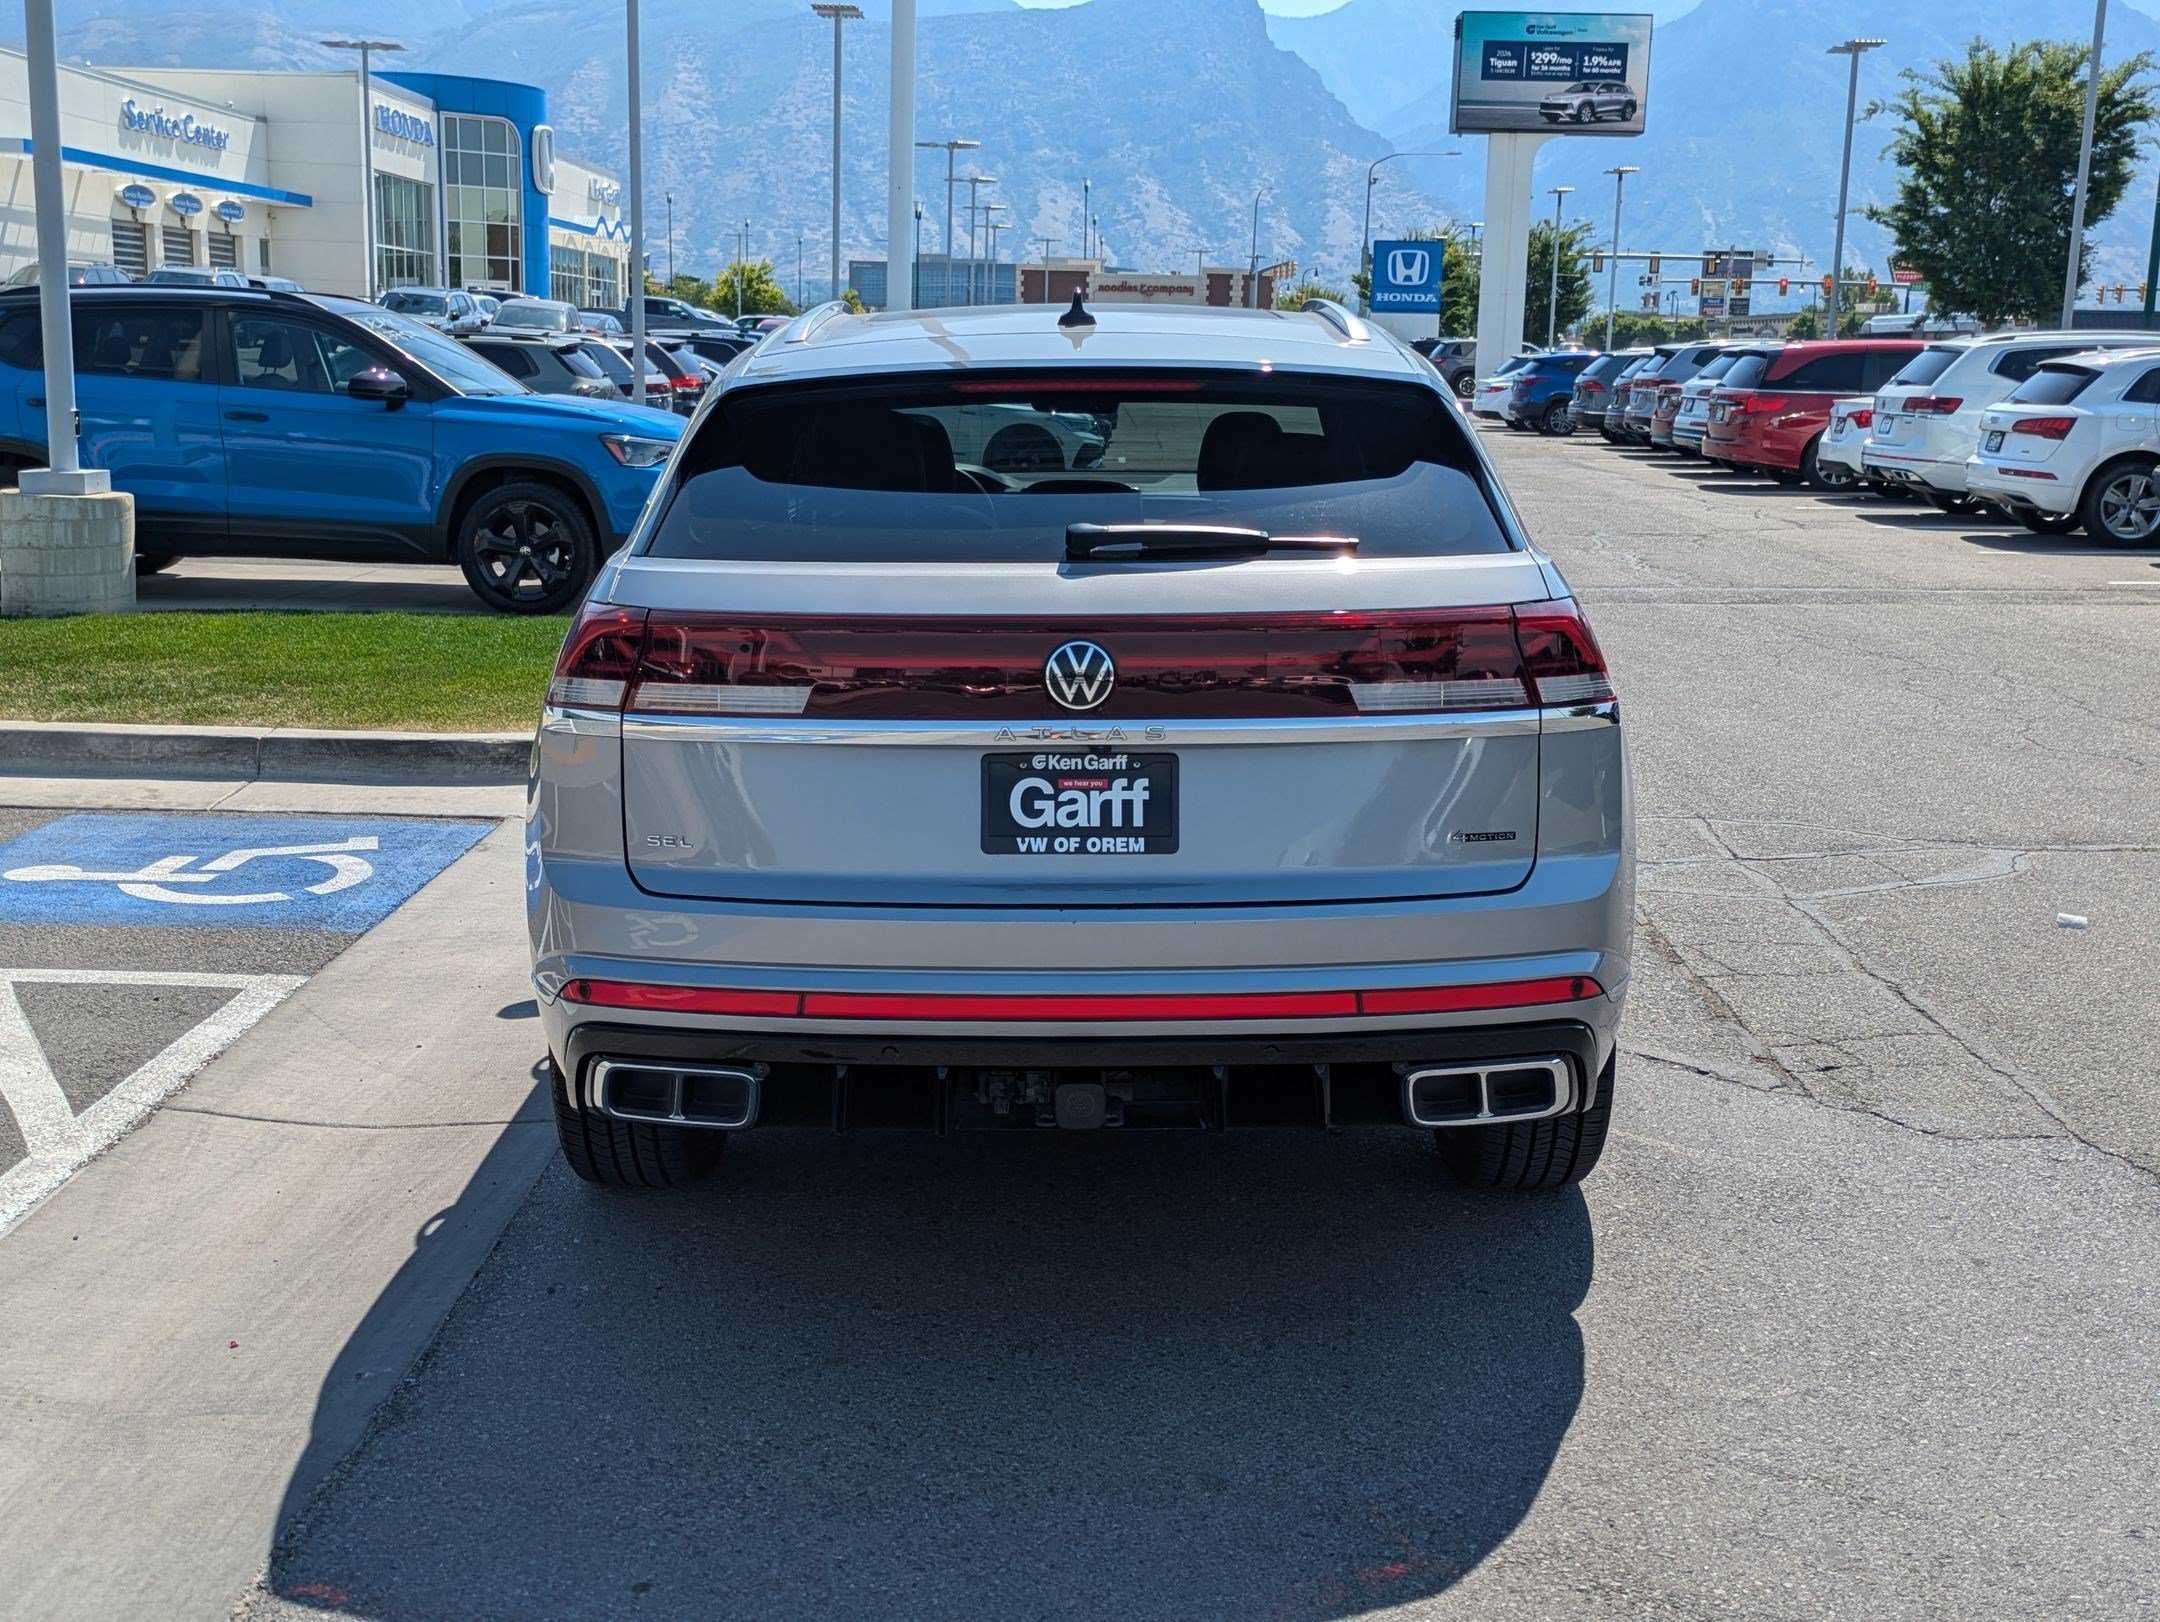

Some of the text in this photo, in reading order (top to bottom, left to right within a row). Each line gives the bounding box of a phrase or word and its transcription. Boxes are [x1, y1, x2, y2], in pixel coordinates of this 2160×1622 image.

[1489, 57, 1518, 68] Tiguan
[1531, 51, 1573, 65] $299/mo
[1583, 55, 1608, 66] 1.9%
[125, 99, 230, 150] Service Center
[376, 104, 434, 147] HONDA
[1098, 281, 1138, 292] noodles
[1147, 285, 1195, 297] company
[1376, 292, 1438, 303] HONDA
[994, 726, 1166, 742] ATLAS
[1048, 754, 1128, 770] Ken Garff
[1075, 779, 1089, 787] hear
[1090, 780, 1103, 789] you
[1009, 777, 1150, 829] Garff
[646, 834, 694, 848] SEL
[1016, 837, 1145, 853] VW OF OREM
